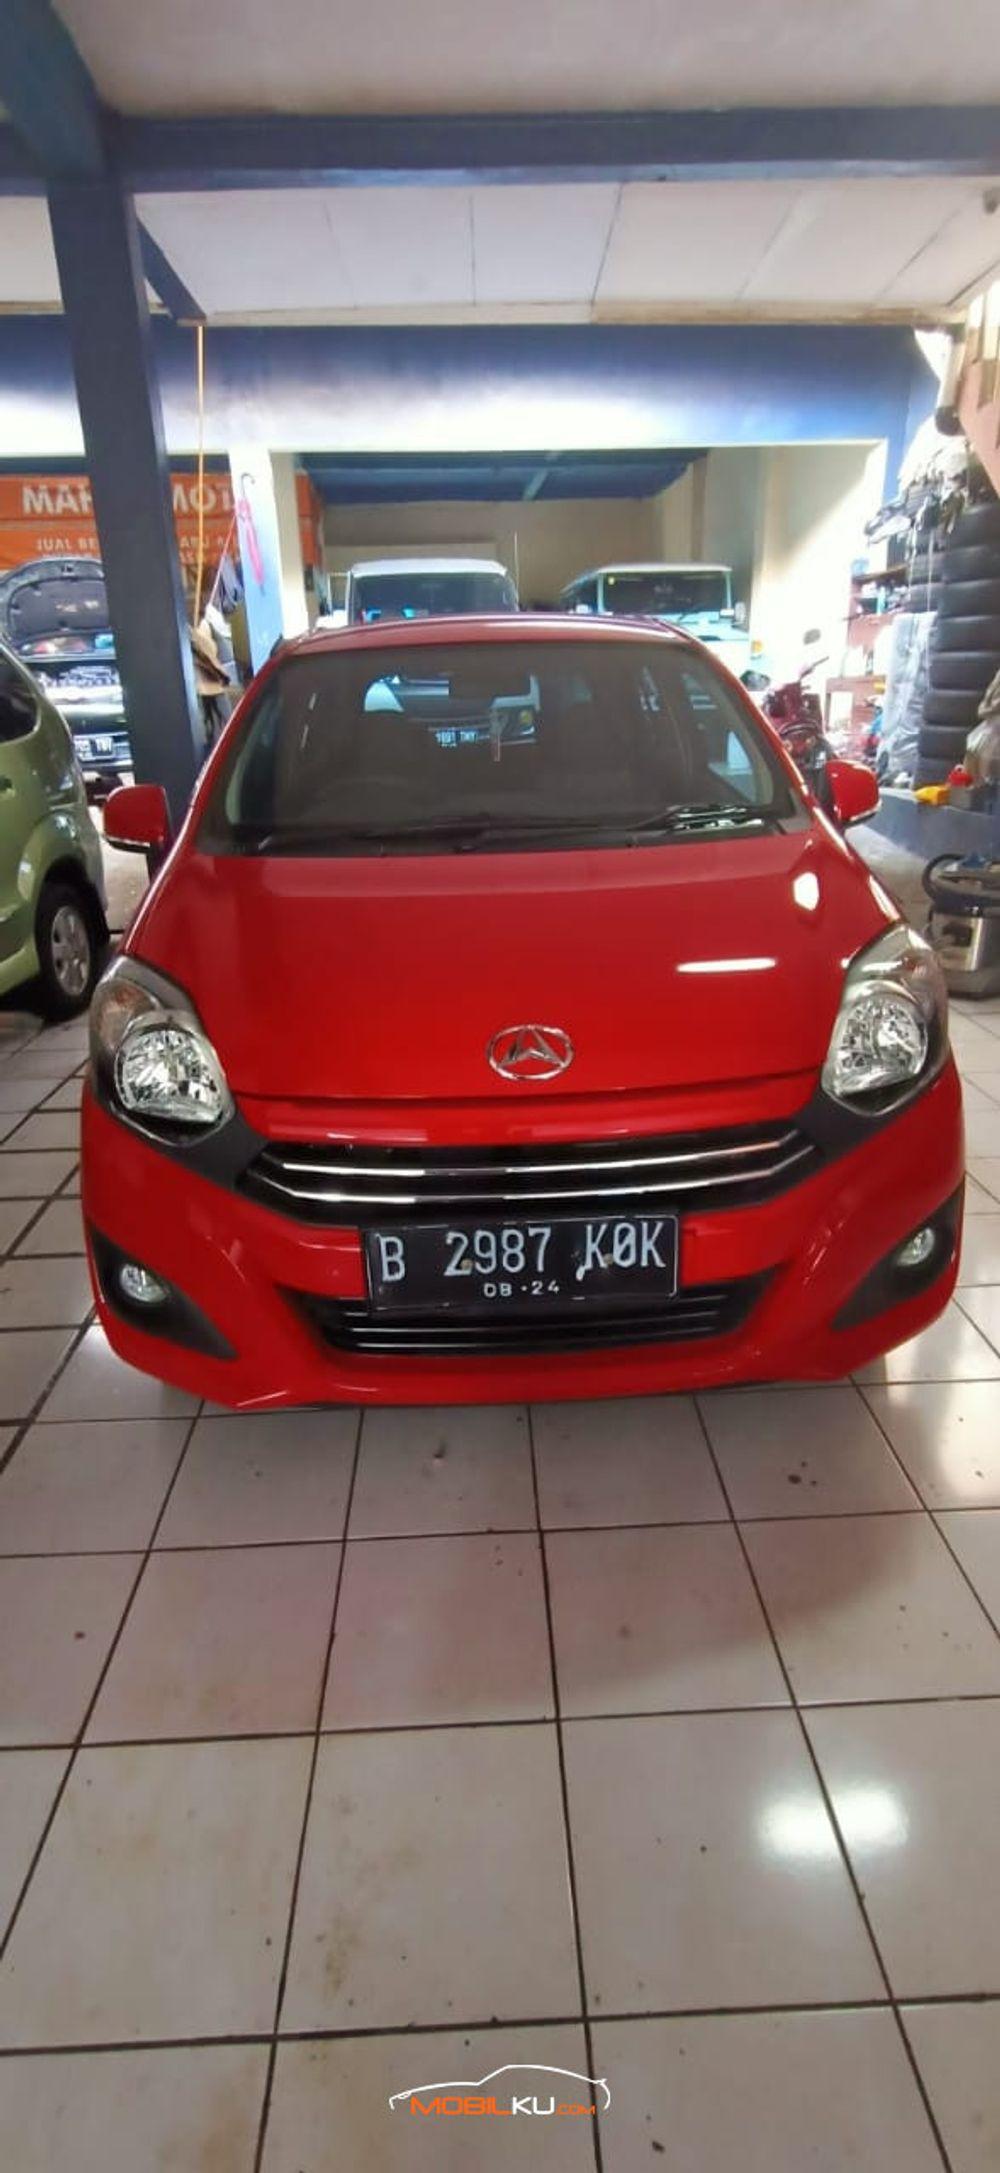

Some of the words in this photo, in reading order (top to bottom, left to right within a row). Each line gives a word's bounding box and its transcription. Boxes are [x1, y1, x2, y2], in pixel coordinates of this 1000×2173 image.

[37, 538, 73, 552] JUAL
[377, 1234, 406, 1283] B
[443, 1227, 552, 1278] 2987
